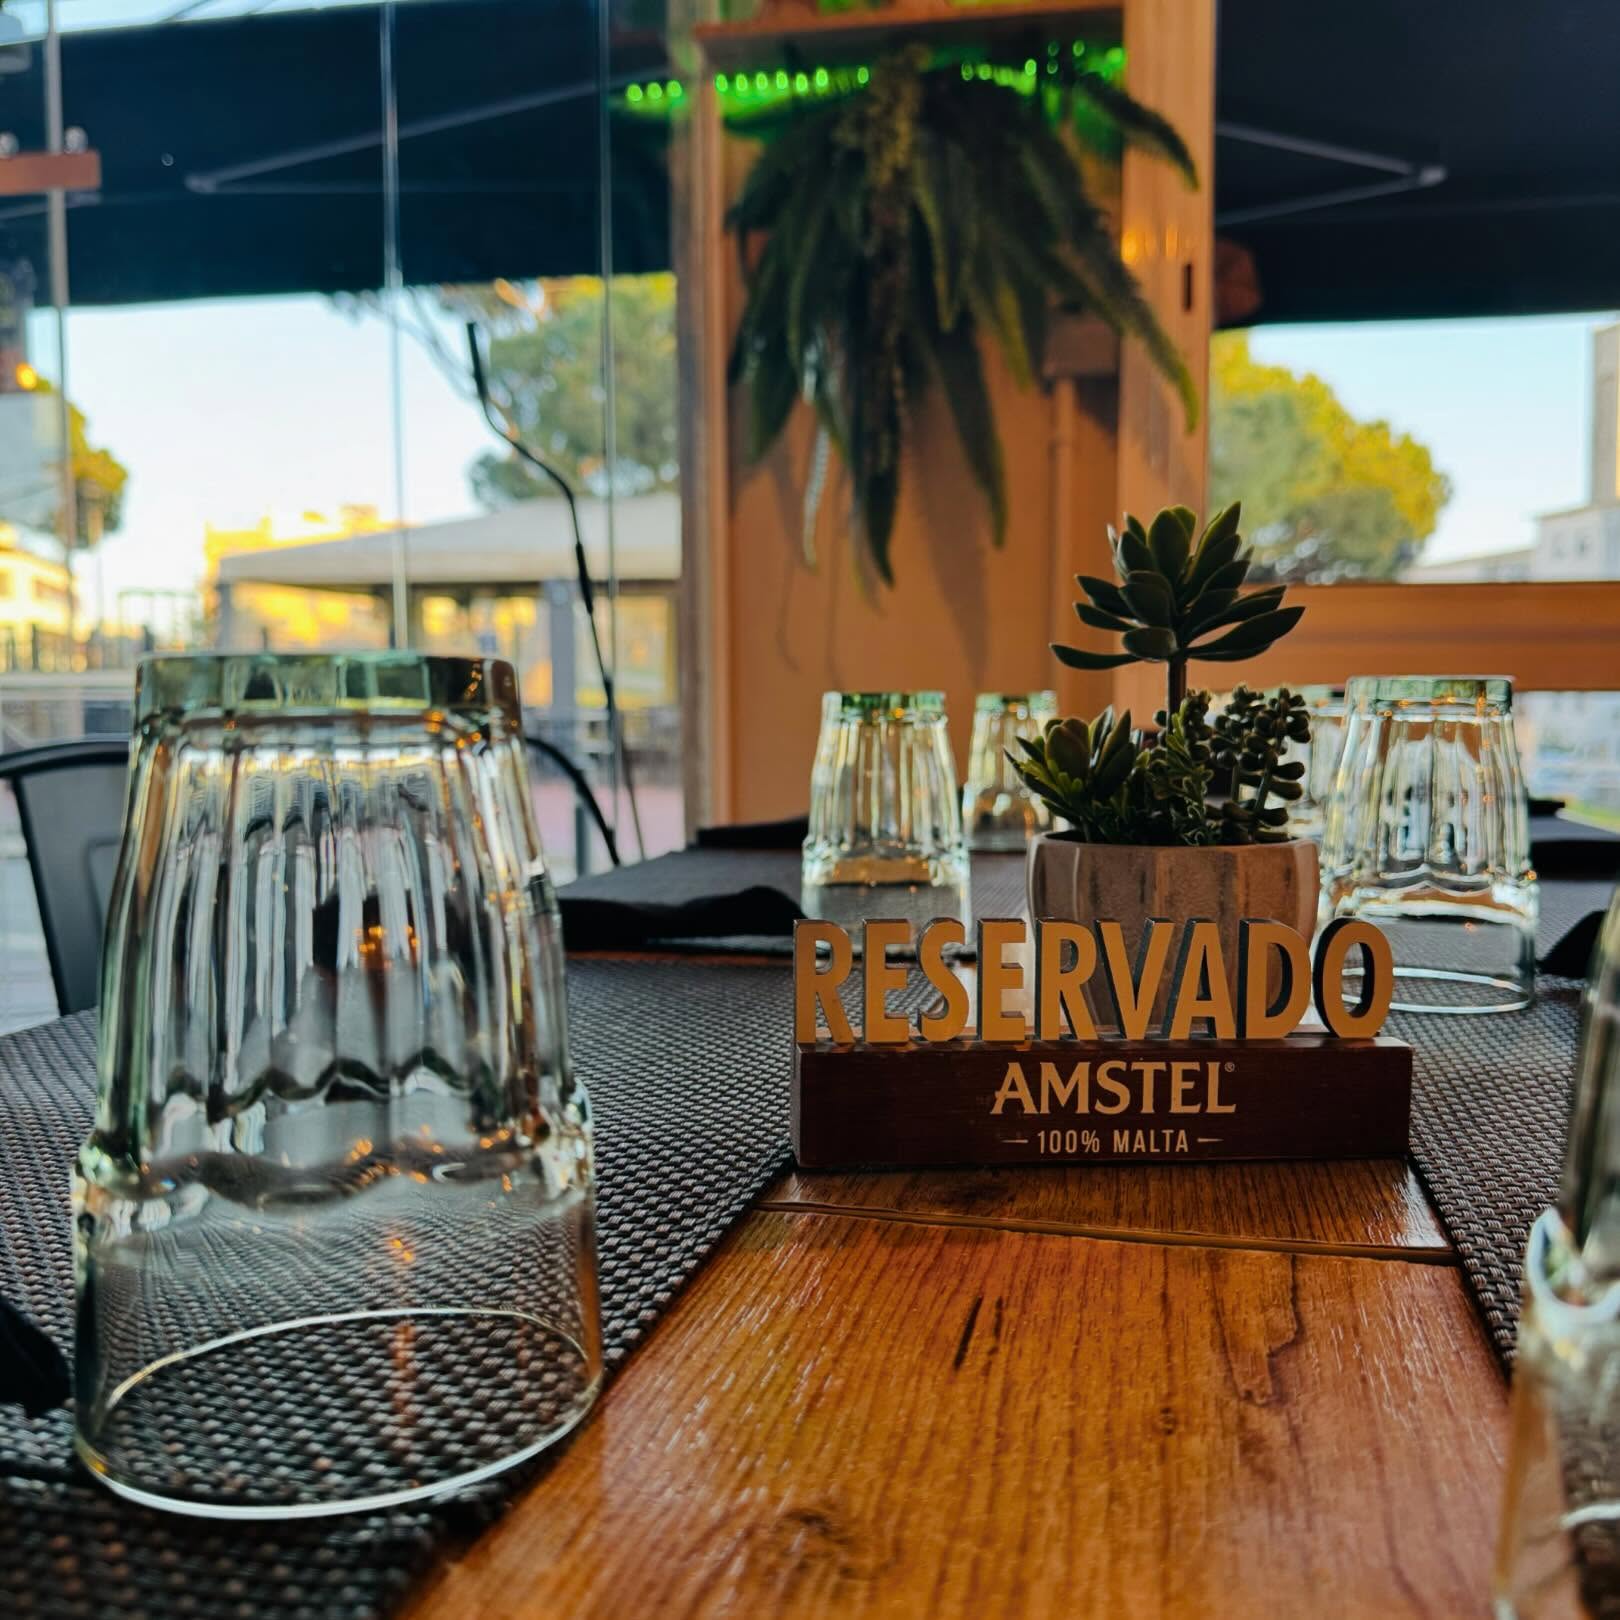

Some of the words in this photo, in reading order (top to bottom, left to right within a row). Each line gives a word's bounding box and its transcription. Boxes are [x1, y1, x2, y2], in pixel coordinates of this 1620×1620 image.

[795, 918, 1394, 1044] RESERVADO
[1037, 1129, 1100, 1154] 100%
[1113, 1129, 1189, 1153] MALTA
